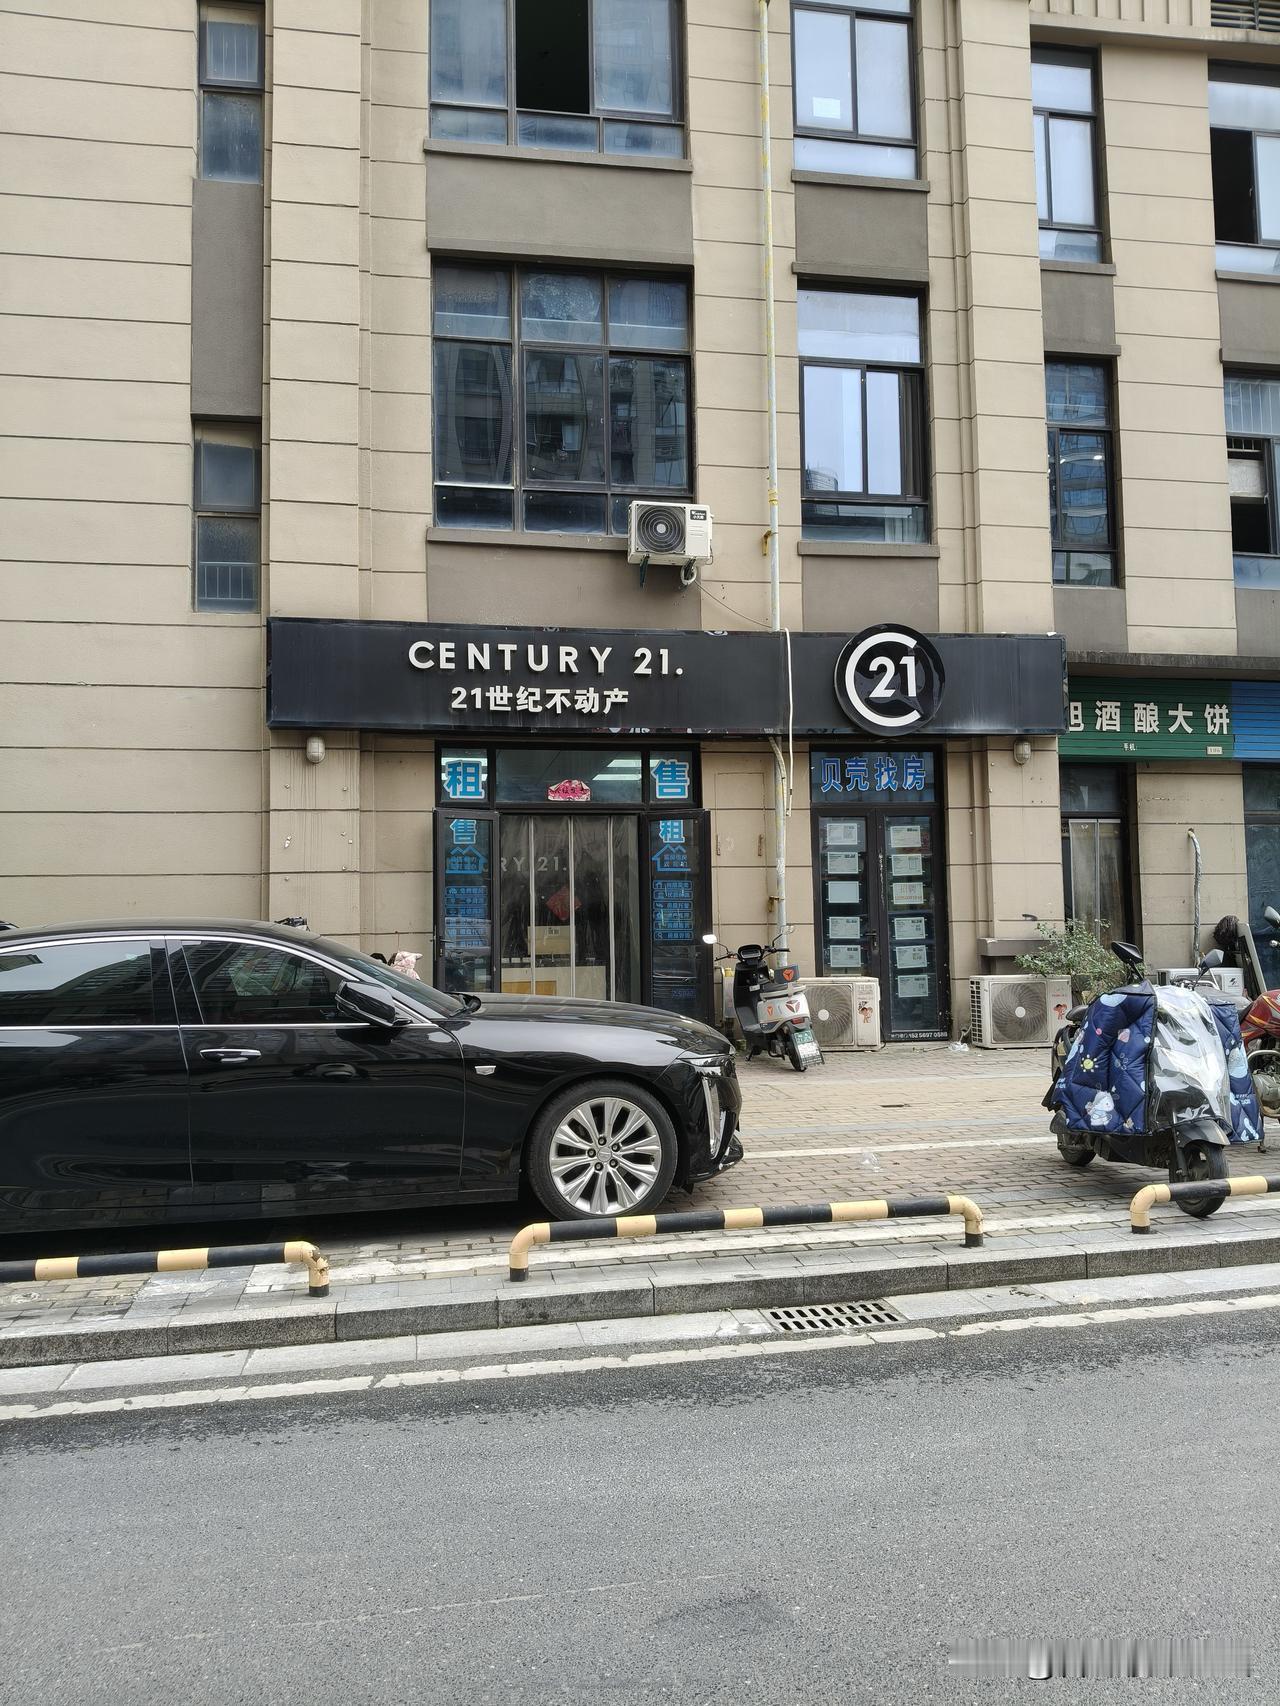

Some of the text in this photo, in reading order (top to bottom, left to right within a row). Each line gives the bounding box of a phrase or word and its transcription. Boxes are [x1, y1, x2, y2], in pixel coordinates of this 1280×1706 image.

[408, 641, 612, 674] CENTURY
[868, 655, 917, 698] 21
[450, 684, 629, 715] 21世纪不动产
[443, 759, 485, 799] 租
[650, 759, 690, 799] 售
[820, 755, 926, 793] 贝壳找房
[449, 818, 477, 845] 售
[658, 819, 686, 843] 租
